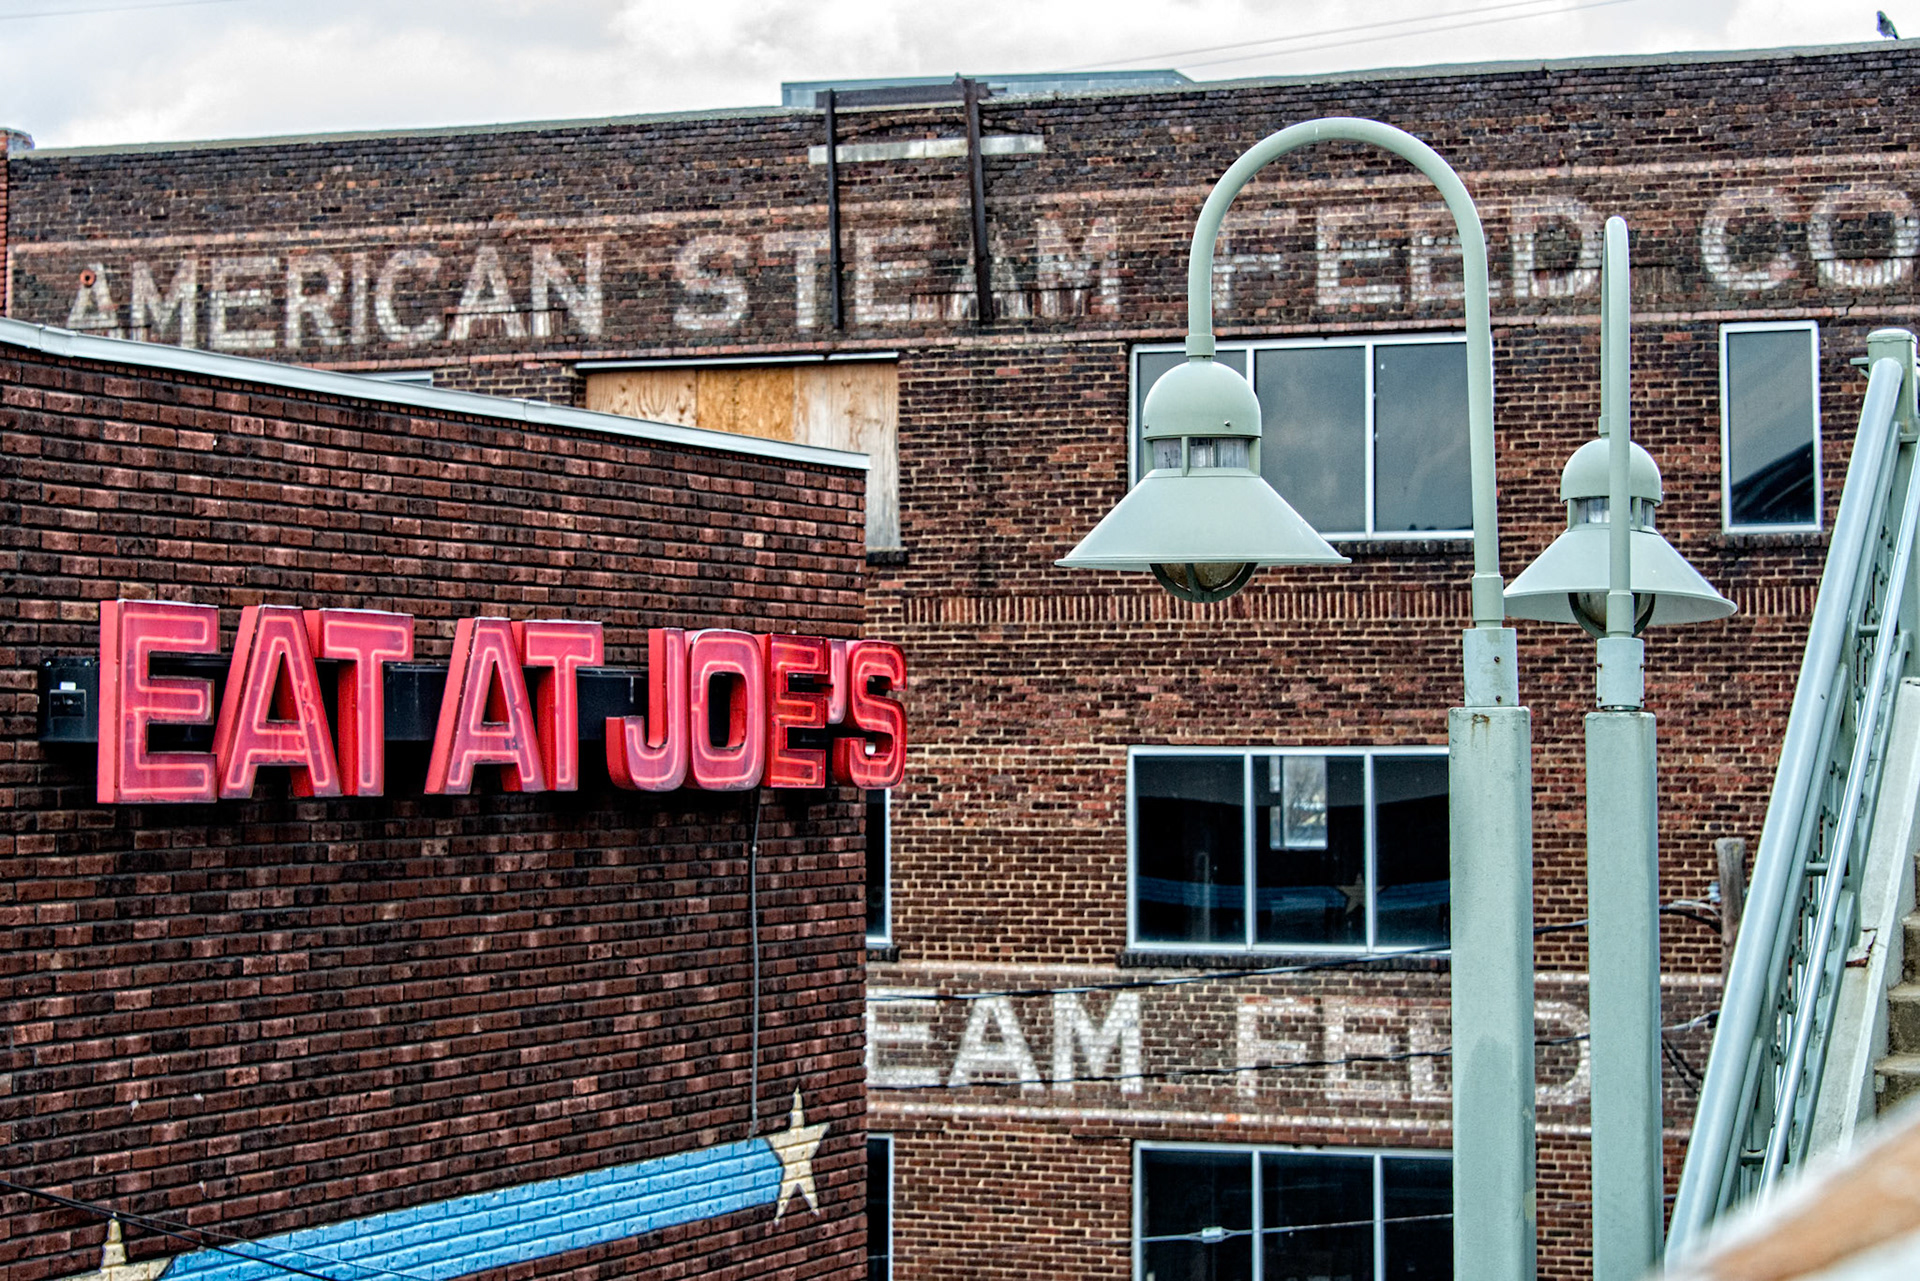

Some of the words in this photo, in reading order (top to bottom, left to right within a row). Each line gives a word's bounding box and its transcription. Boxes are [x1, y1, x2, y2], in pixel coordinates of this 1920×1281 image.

[66, 242, 604, 349] AMERICAN
[672, 215, 1121, 331] STEAM
[1193, 201, 1602, 309] FEED
[97, 599, 414, 804] EAT
[424, 616, 603, 795] AT
[606, 627, 907, 793] JOE'S
